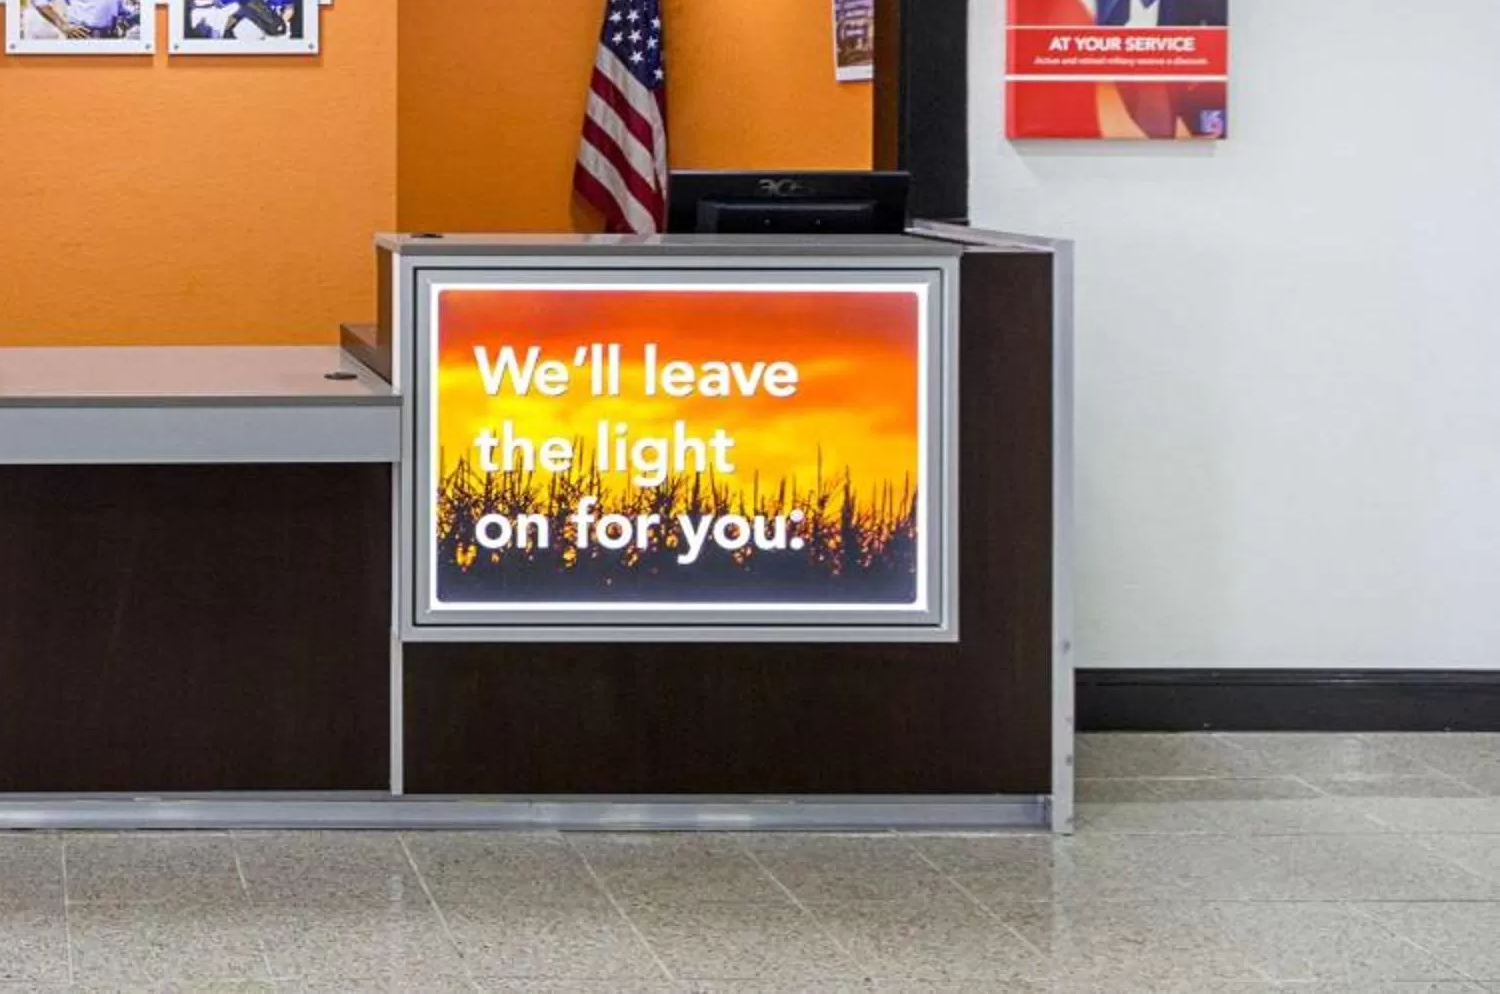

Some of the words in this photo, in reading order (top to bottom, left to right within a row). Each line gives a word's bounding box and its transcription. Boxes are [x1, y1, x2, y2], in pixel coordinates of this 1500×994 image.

[1048, 36, 1072, 52] AT
[1075, 36, 1121, 52] YOUR
[1125, 37, 1196, 52] SERVICE
[473, 343, 621, 397] We'll
[644, 343, 799, 397] leave
[474, 420, 574, 474] the
[596, 419, 736, 488] light
[474, 510, 550, 551] on
[572, 495, 660, 551] for
